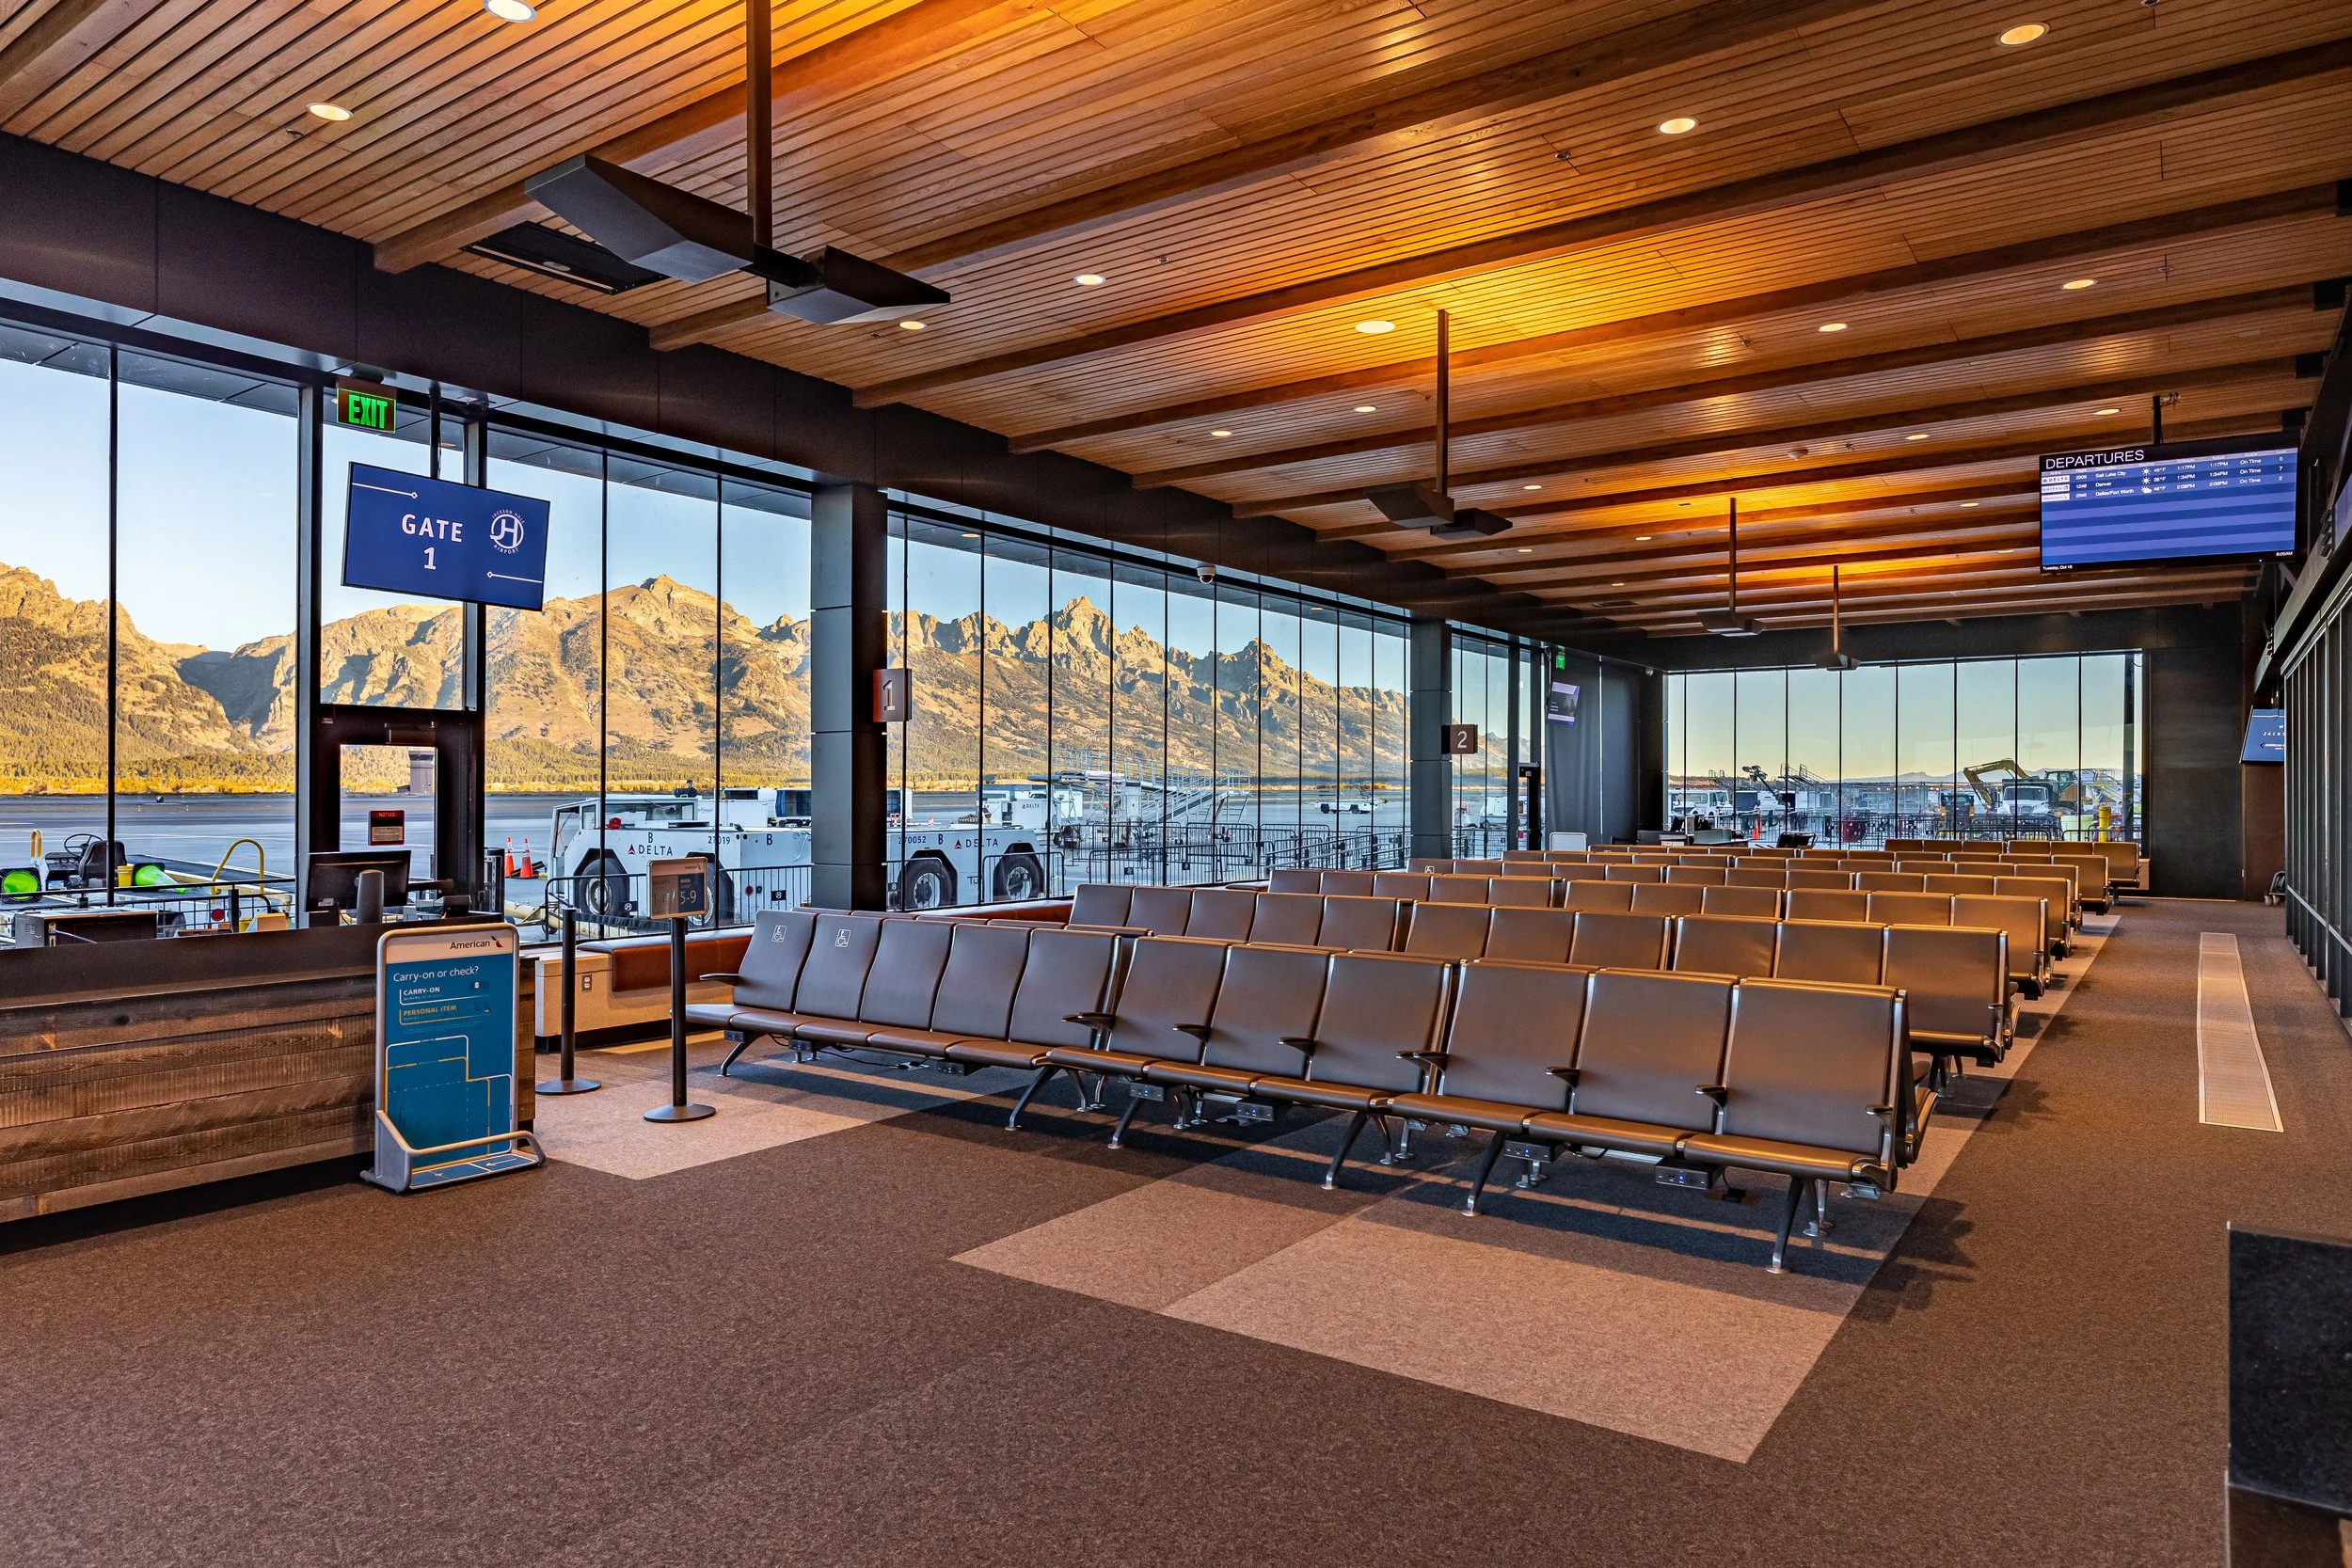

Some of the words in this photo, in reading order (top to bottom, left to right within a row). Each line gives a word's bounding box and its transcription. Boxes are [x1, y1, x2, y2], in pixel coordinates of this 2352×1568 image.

[348, 394, 388, 429] EXIT
[2045, 450, 2145, 469] DEPARTURES
[491, 509, 513, 519] JACKSON
[514, 512, 525, 524] HOLE
[402, 514, 463, 543] GATE
[493, 544, 519, 555] AIRPORT
[423, 546, 437, 570] 1
[882, 679, 896, 711] 1
[1457, 730, 1468, 749] 2
[648, 832, 653, 844] B
[766, 833, 773, 846] B
[938, 833, 944, 845] B
[965, 838, 998, 847] DETA
[639, 844, 673, 856] DELTA
[680, 890, 697, 904] 5-9
[450, 940, 490, 950] American
[392, 970, 436, 983] Carry-on
[437, 969, 447, 977] or
[449, 965, 479, 976] check?
[404, 987, 440, 996] CARRY-ON
[404, 1007, 438, 1016] PERSONAL
